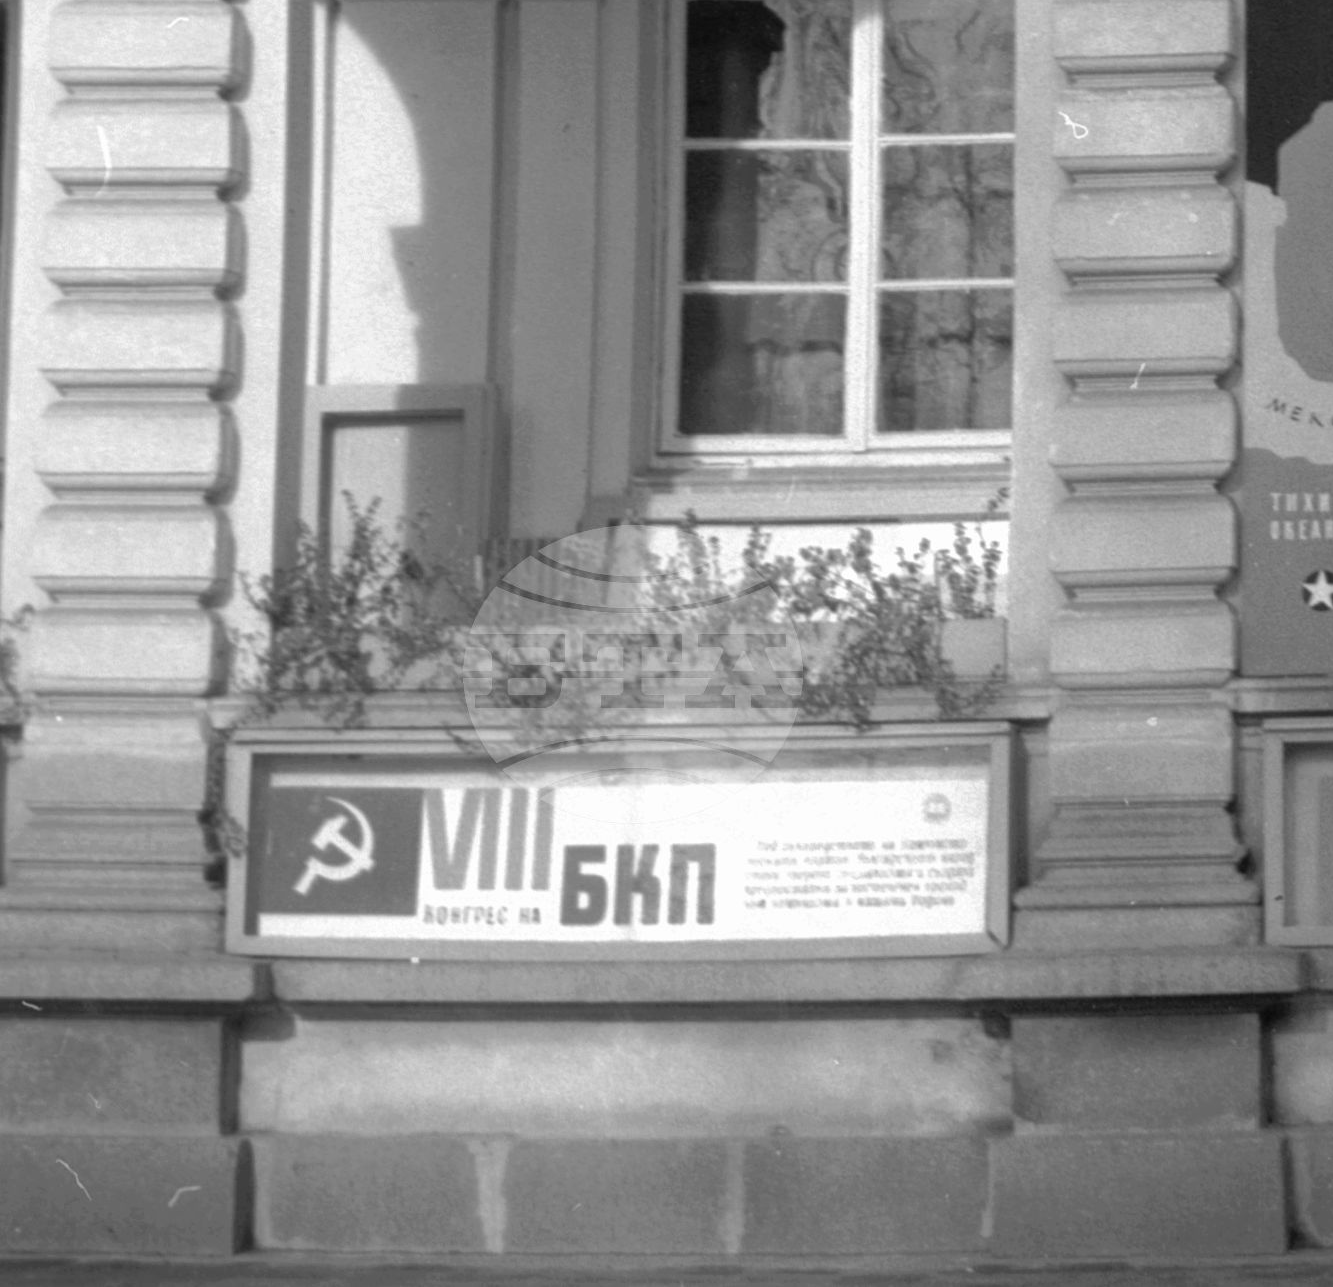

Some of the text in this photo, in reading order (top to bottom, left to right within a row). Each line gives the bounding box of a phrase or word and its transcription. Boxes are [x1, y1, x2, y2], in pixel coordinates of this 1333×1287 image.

[423, 788, 555, 891] VIII
[422, 903, 542, 926] КОНГРЕС НА
[559, 843, 717, 926] БКП
